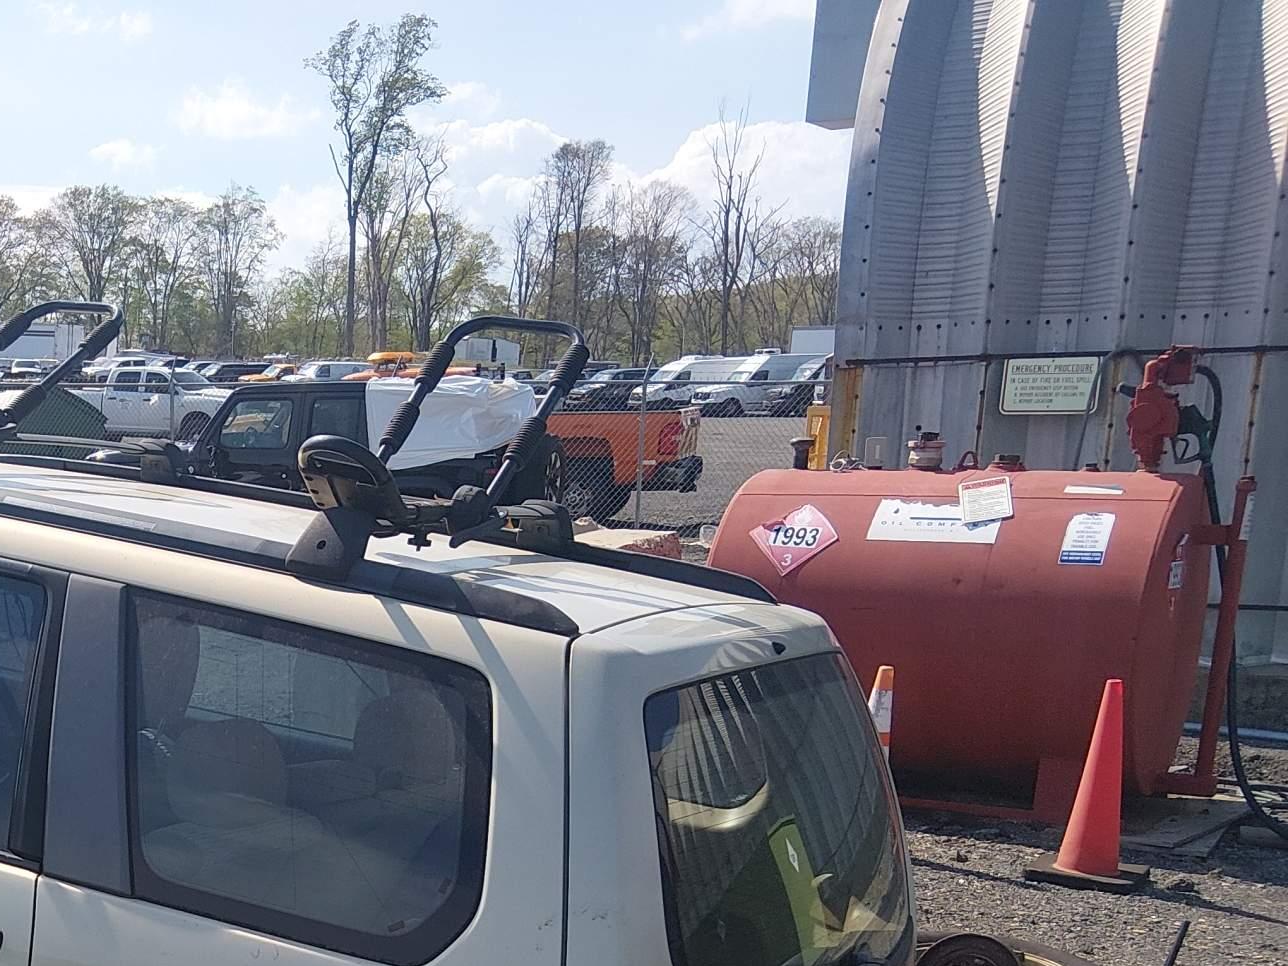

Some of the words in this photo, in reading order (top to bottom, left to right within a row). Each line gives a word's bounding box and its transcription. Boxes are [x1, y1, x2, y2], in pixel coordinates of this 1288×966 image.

[1012, 365, 1051, 373] EMERGENCY
[1053, 364, 1094, 373] PROCEDURE
[772, 526, 820, 547] 1993
[781, 554, 793, 566] 3
